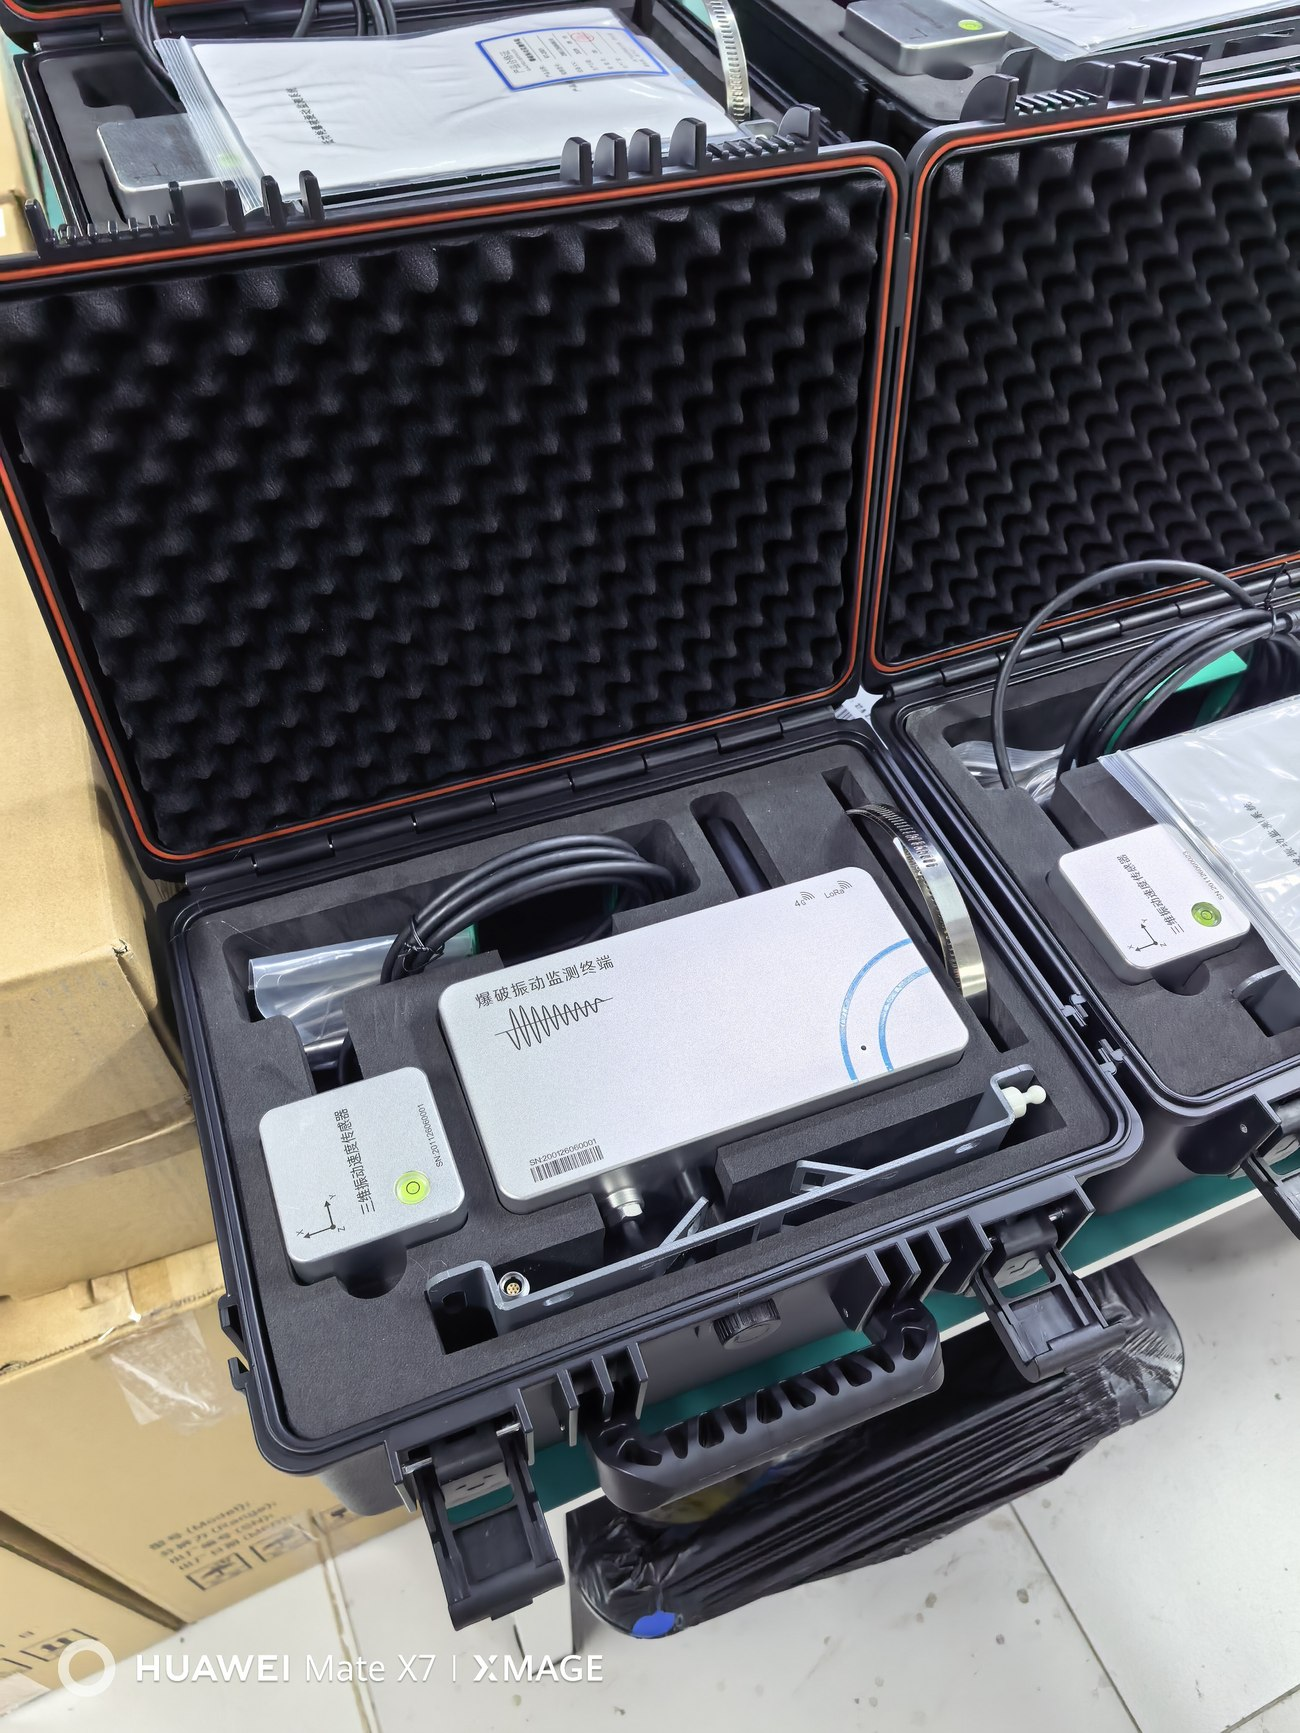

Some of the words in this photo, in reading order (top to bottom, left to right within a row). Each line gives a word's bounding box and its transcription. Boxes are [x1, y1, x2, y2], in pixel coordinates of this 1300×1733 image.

[824, 889, 845, 899] LoRa
[1117, 854, 1185, 935] 三维振动速度传感器
[475, 955, 614, 1009] 爆破振动监测终端
[334, 1108, 375, 1214] 三维振动速度传感器
[417, 1104, 443, 1168] SN:201126060001
[529, 1138, 597, 1166] SN:200126060001
